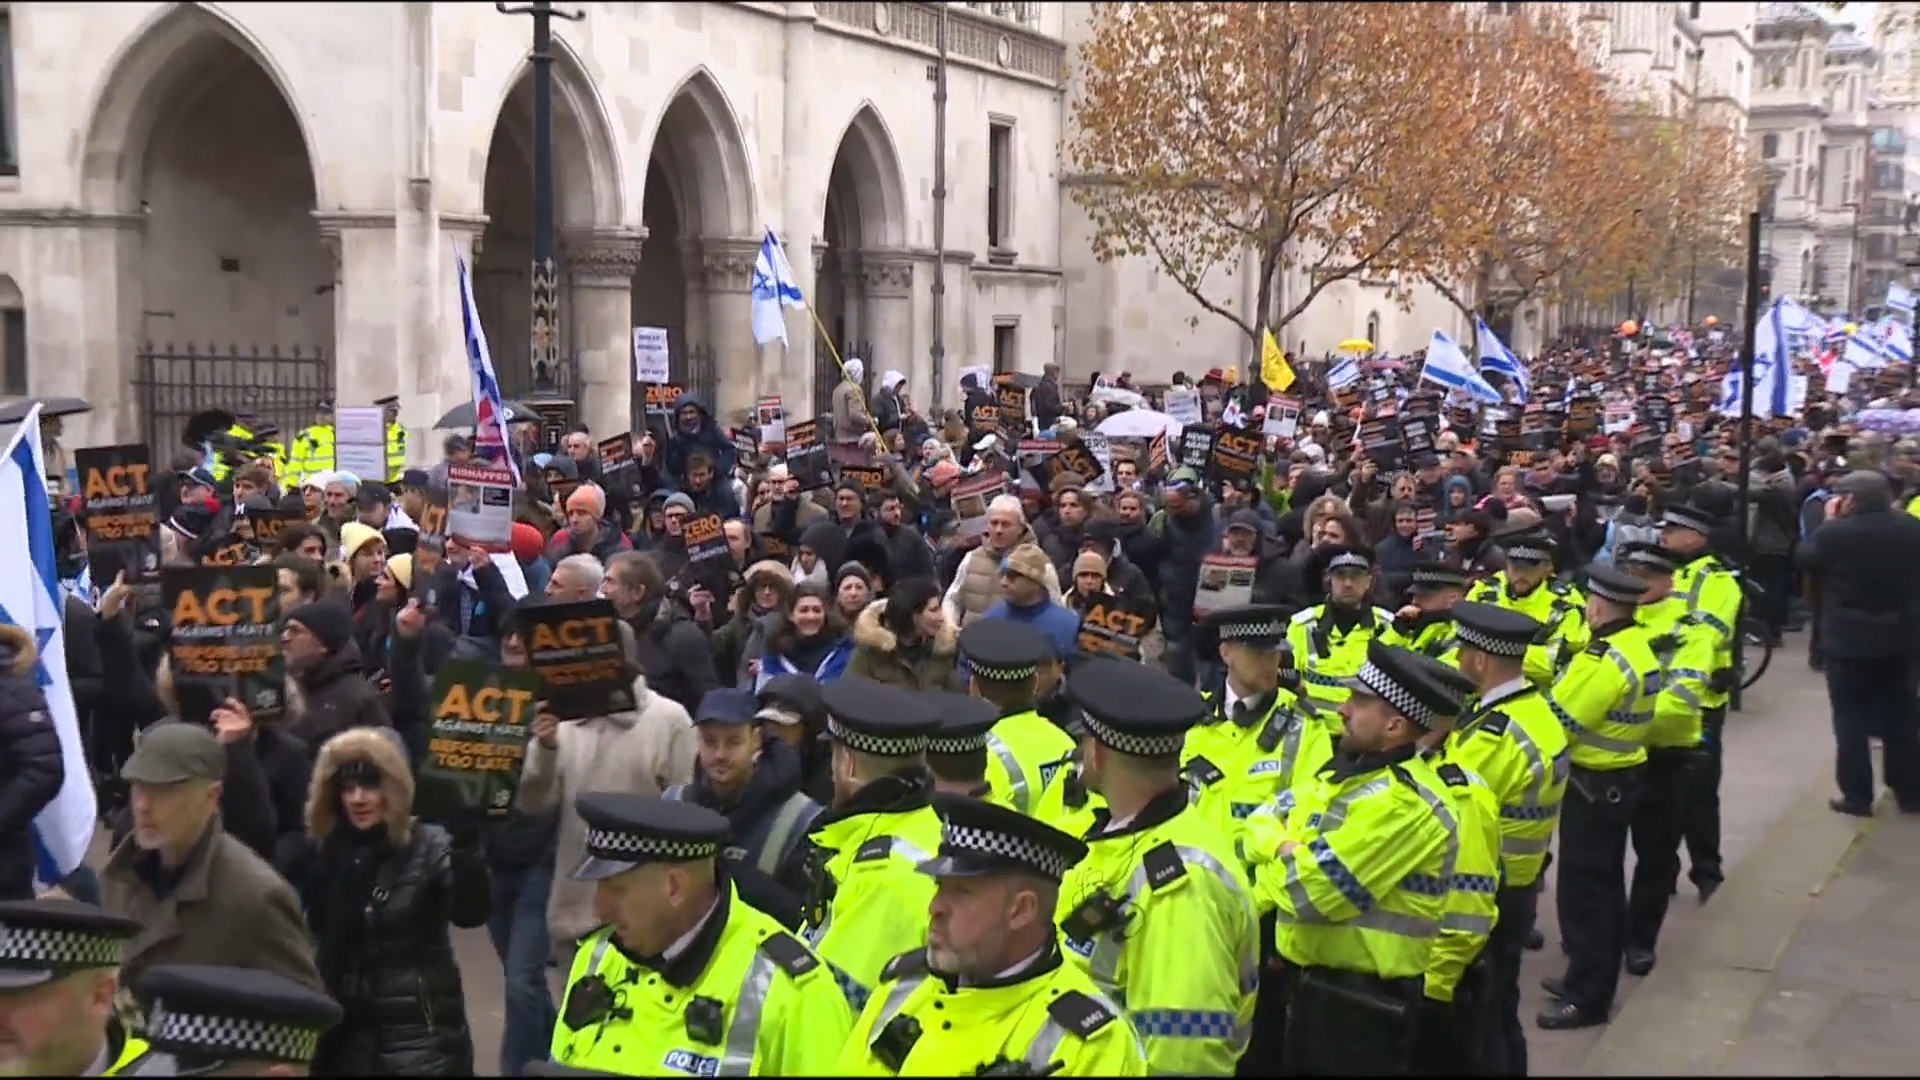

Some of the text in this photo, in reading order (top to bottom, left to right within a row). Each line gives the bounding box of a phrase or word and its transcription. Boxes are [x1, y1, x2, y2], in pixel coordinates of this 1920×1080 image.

[1220, 432, 1259, 453] ACT
[86, 463, 148, 498] ACT
[450, 468, 511, 482] KIDNAPPED
[683, 513, 721, 536] ZERO
[172, 588, 273, 625] ACT
[1086, 604, 1144, 635] ACT
[172, 625, 232, 638] AGAINST
[531, 616, 614, 650] ACT
[434, 684, 533, 723] ACT
[432, 719, 528, 738] AGAINST HATE
[429, 738, 495, 757] BEFORE
[437, 753, 513, 771] TOO LATE
[667, 1052, 717, 1074] POLICE
